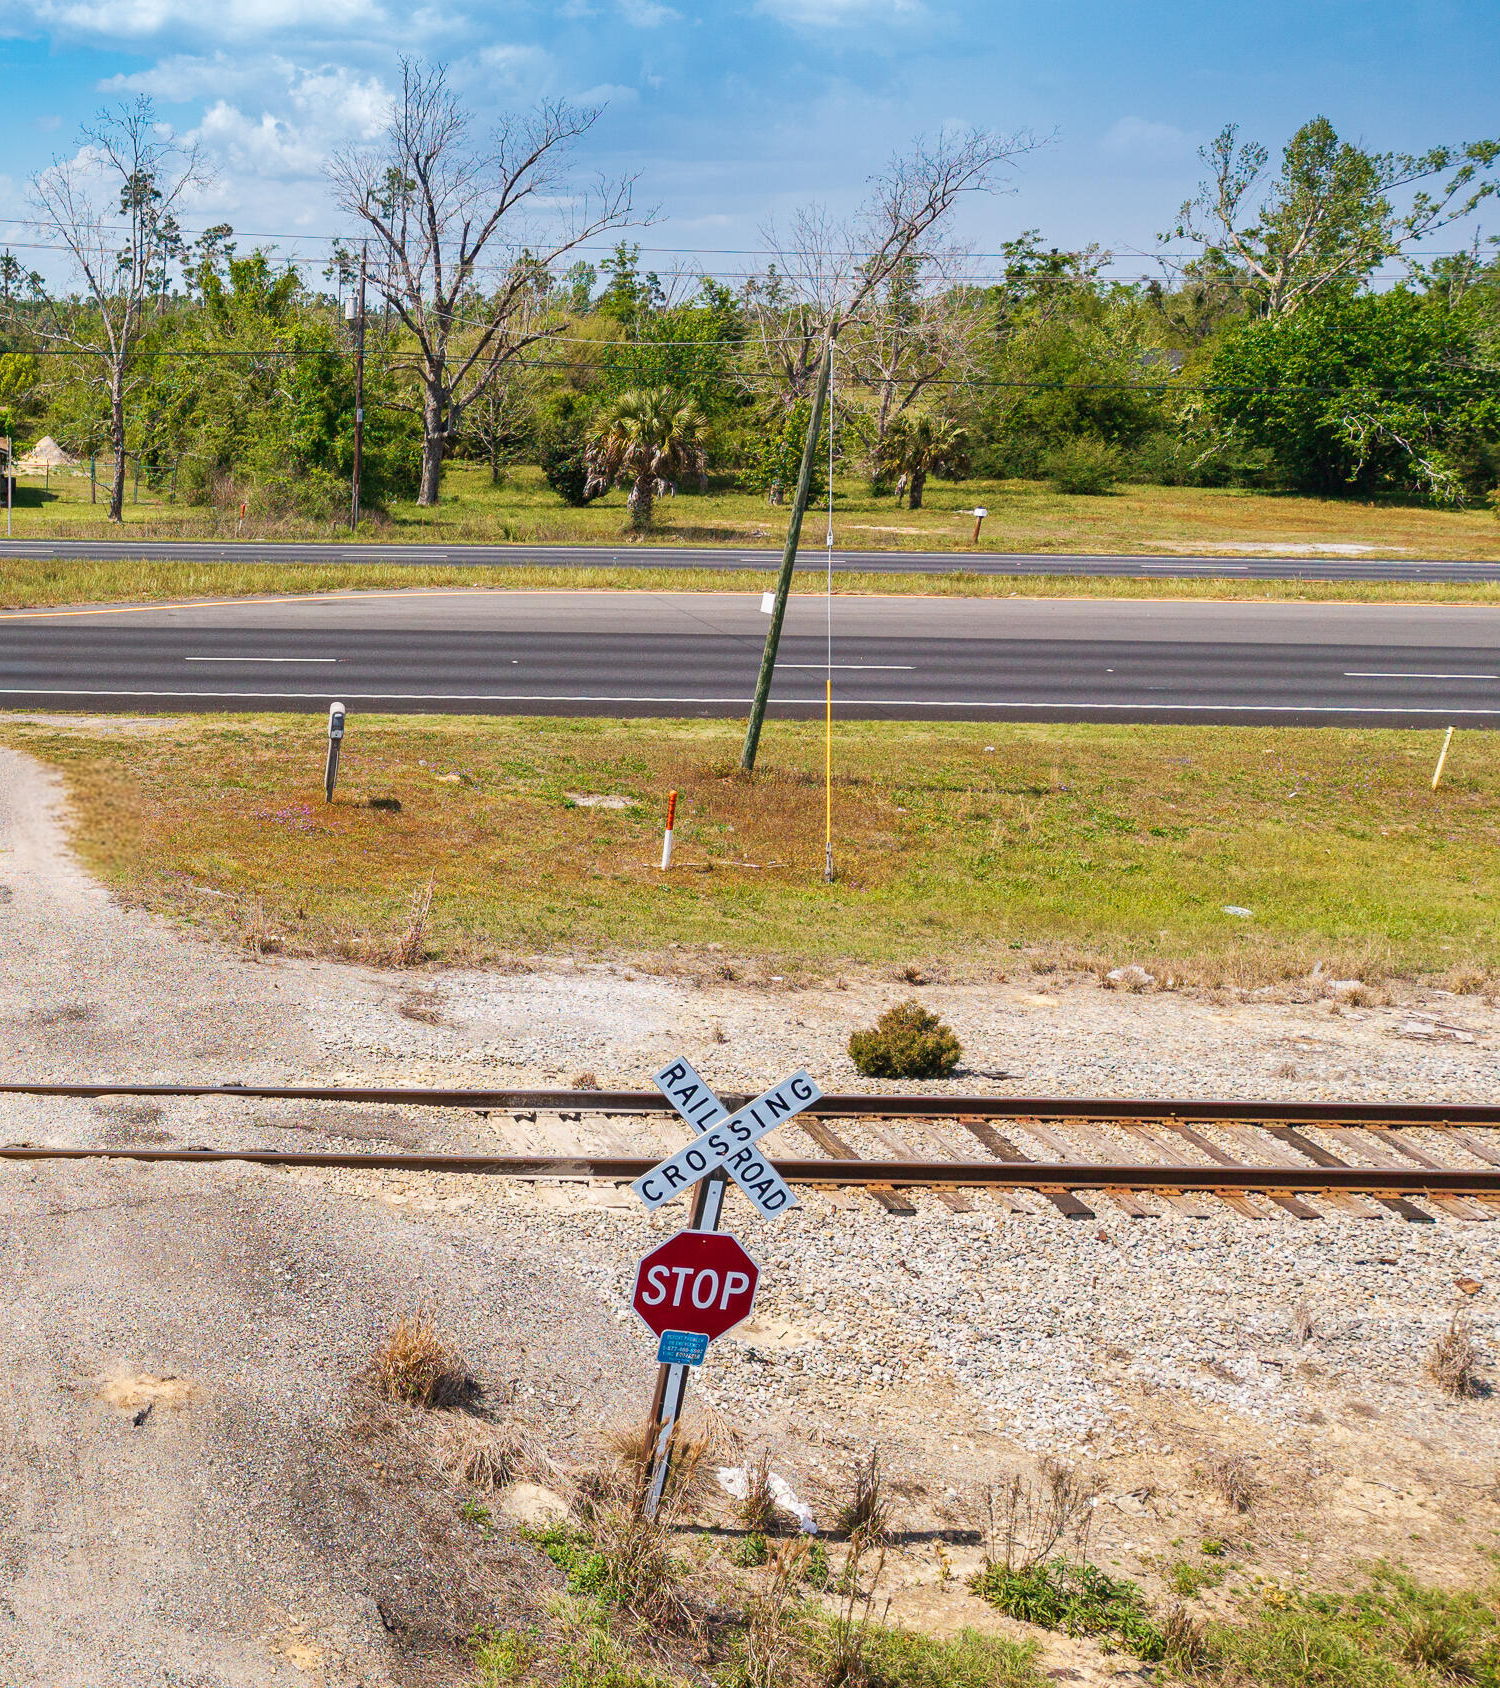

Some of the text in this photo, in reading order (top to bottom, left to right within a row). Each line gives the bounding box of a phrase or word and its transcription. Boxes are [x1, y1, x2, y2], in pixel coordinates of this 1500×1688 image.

[642, 1078, 812, 1201] CROSSING
[660, 1063, 787, 1211] RAIL ROAD
[642, 1265, 750, 1310] STOP
